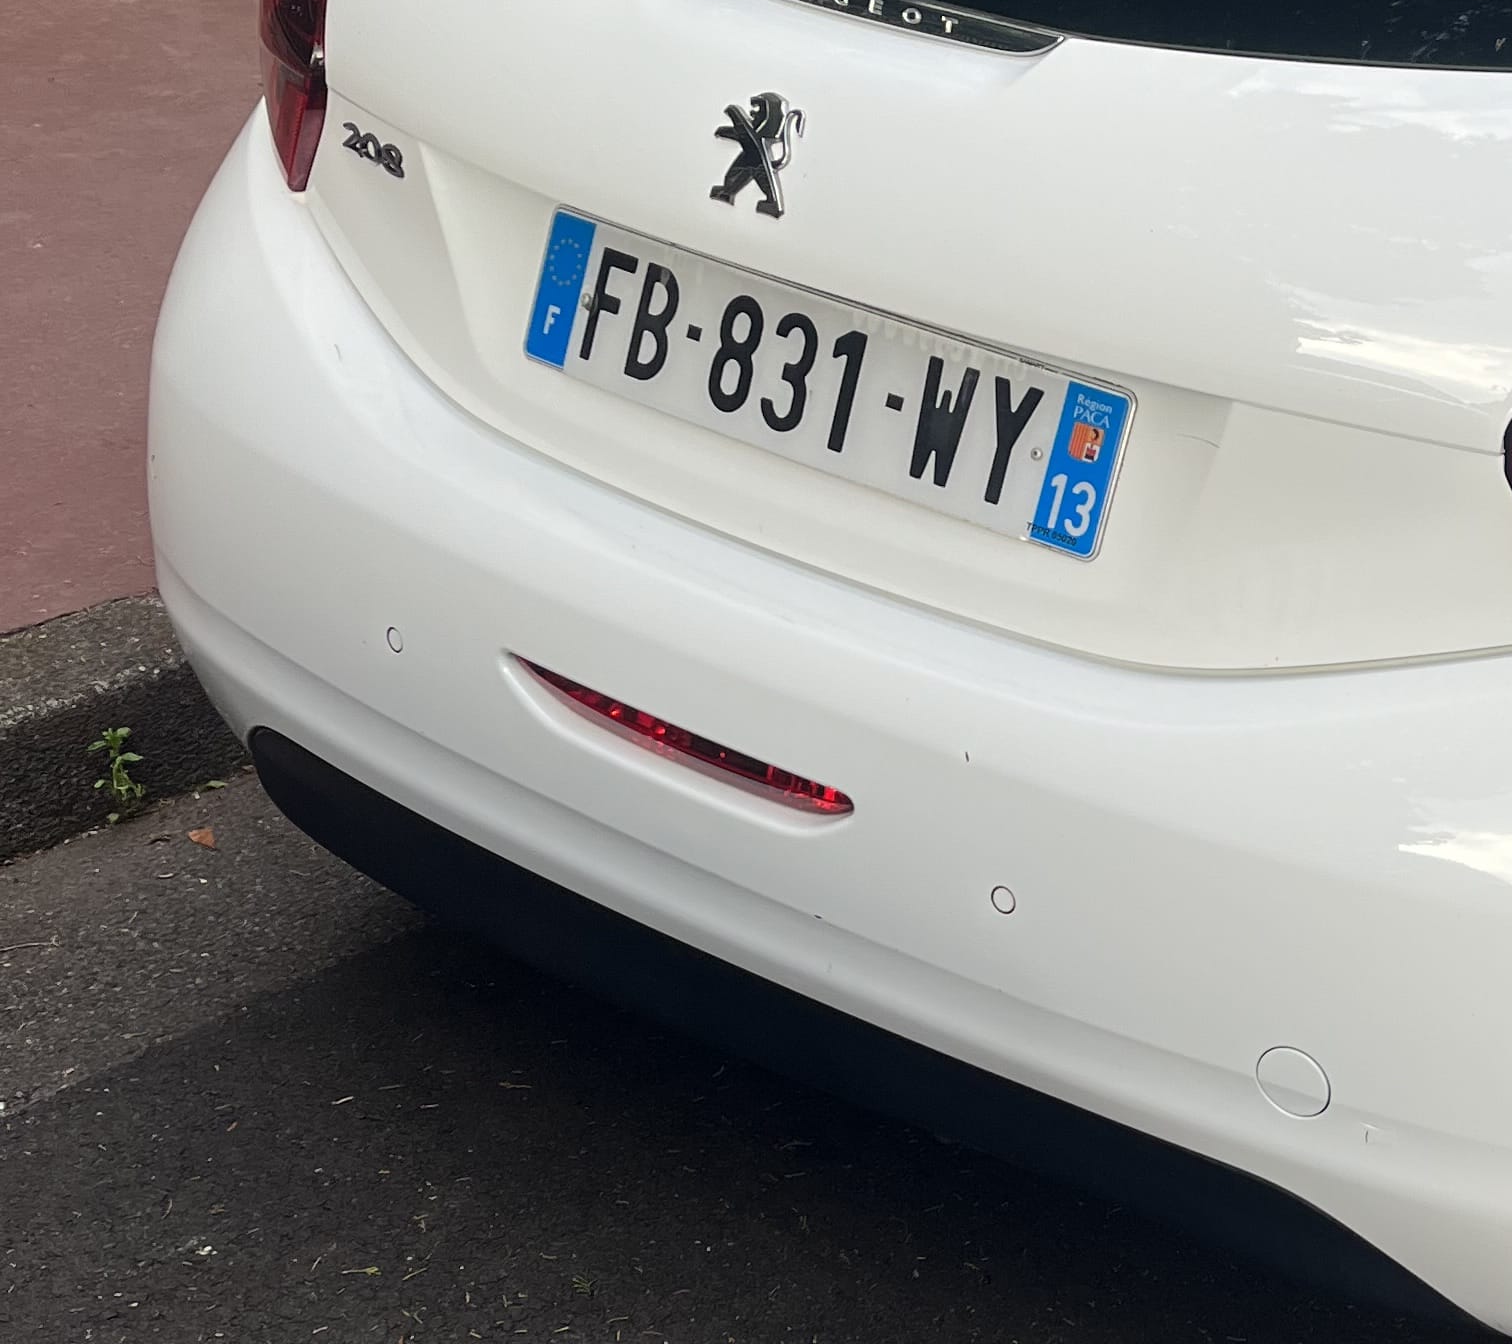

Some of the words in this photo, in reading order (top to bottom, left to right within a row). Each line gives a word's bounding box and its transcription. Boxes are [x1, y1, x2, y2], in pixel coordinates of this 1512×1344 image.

[342, 121, 405, 179] 208
[541, 306, 561, 336] F
[579, 247, 1044, 505] FB-831-WY
[1073, 404, 1111, 429] PACA
[1076, 393, 1113, 415] Région
[1047, 473, 1097, 537] 13
